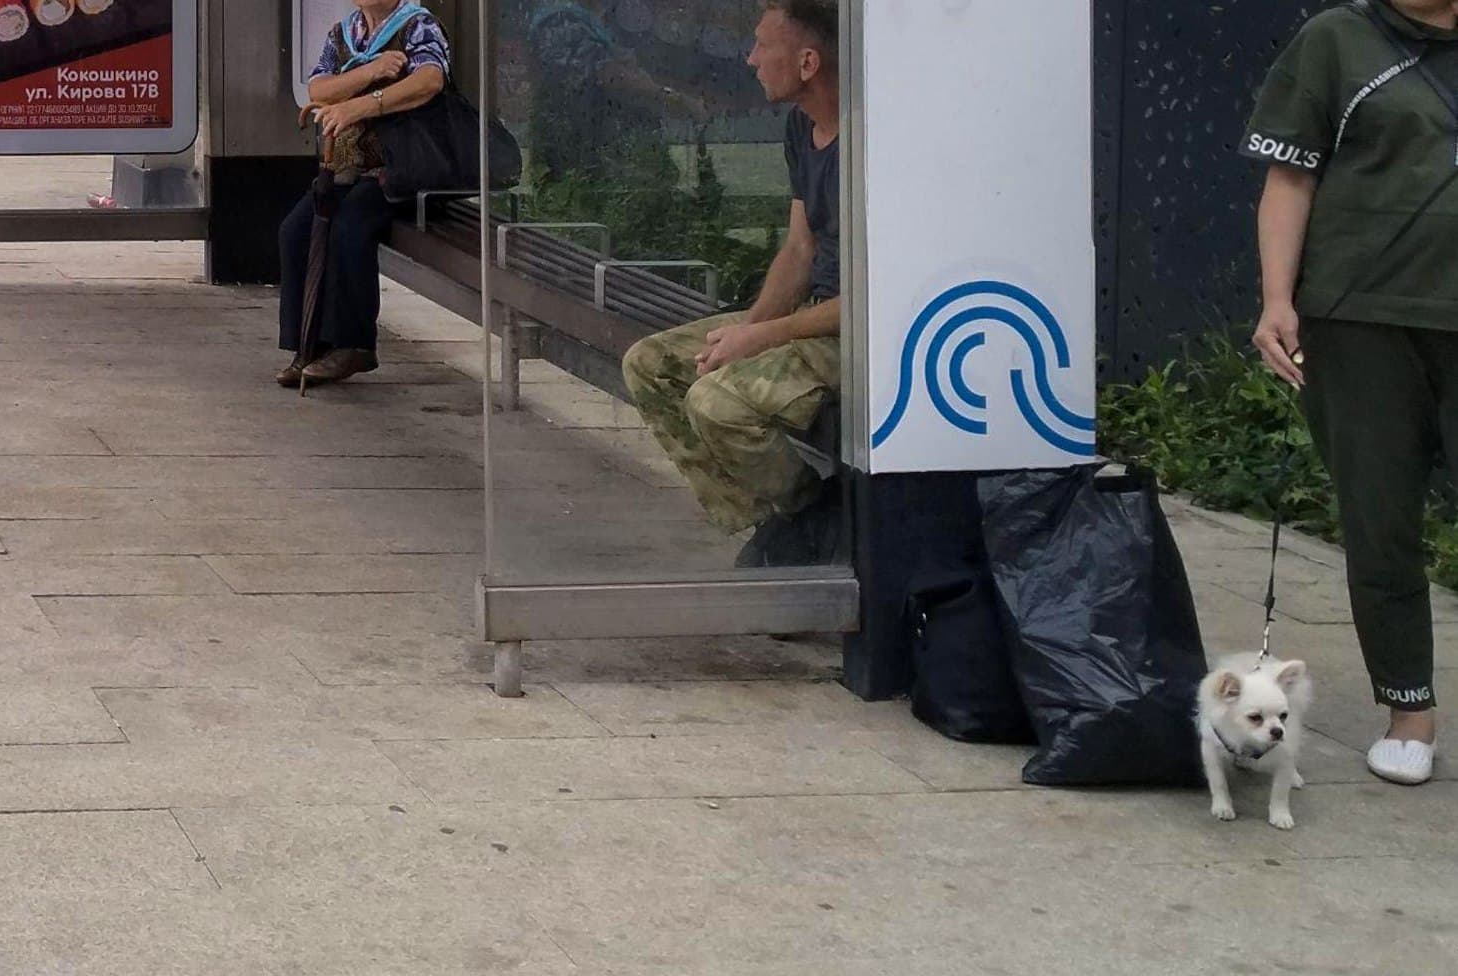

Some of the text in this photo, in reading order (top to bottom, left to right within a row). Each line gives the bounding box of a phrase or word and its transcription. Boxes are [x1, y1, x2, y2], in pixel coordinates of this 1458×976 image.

[56, 67, 159, 82] Кокошкино
[25, 87, 52, 103] ул.
[57, 84, 126, 102] Кирова
